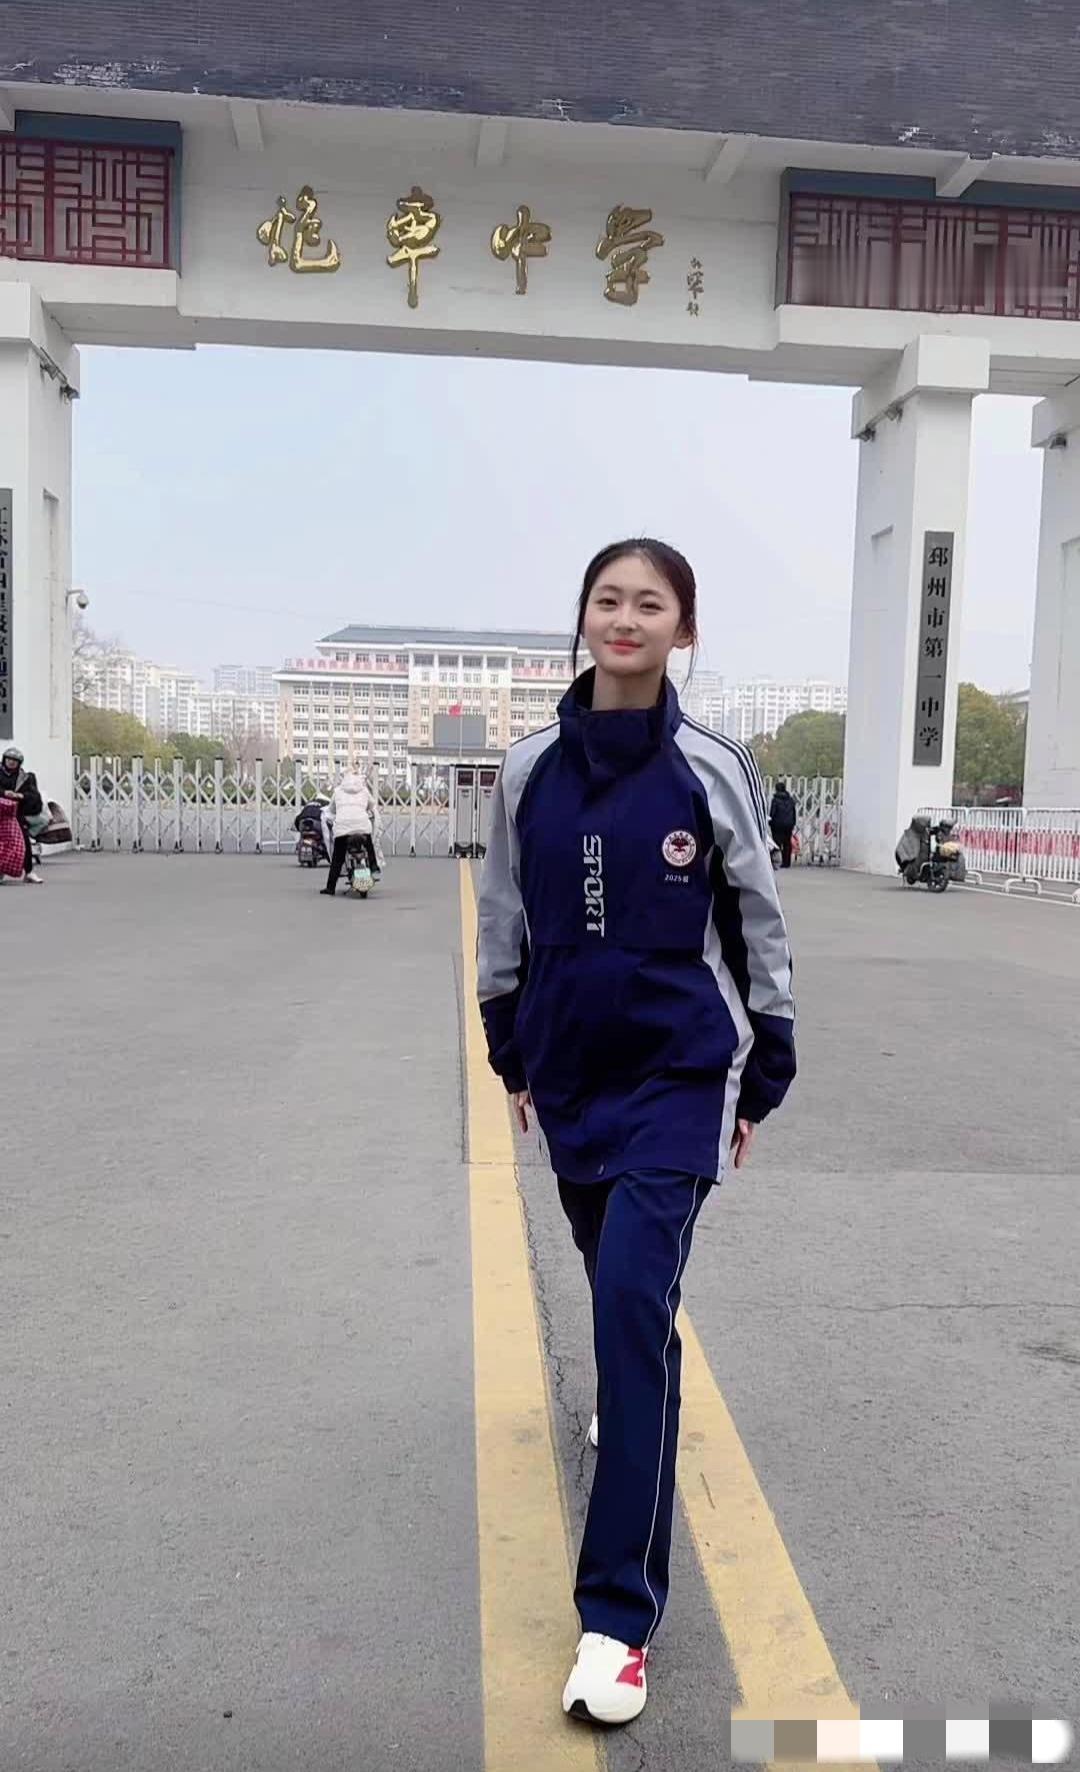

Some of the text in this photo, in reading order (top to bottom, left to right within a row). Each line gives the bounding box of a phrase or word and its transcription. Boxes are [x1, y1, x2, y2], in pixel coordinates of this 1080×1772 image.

[919, 546, 949, 748] 邳州市第一中学
[583, 834, 605, 938] SPORT
